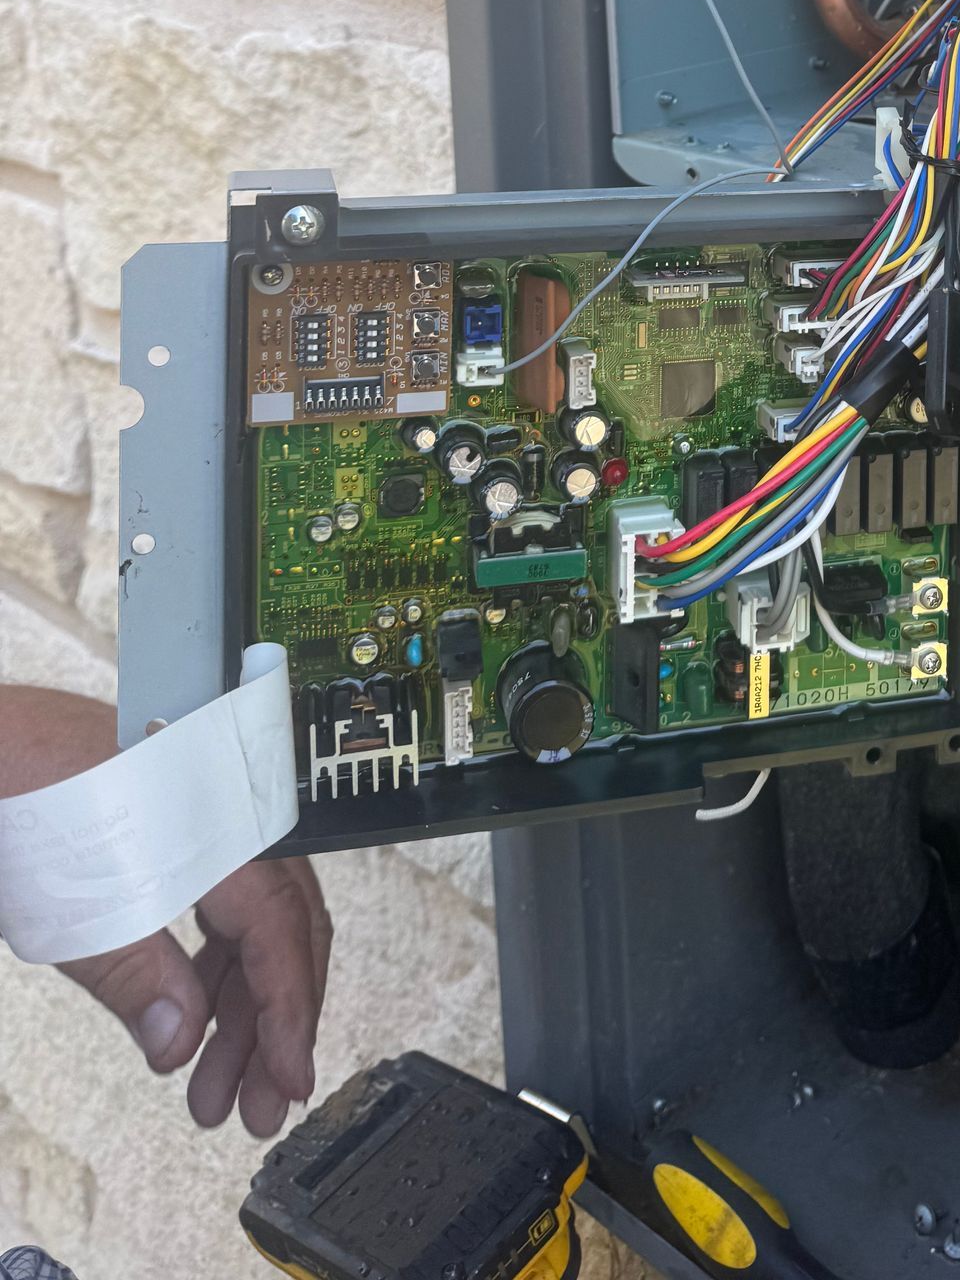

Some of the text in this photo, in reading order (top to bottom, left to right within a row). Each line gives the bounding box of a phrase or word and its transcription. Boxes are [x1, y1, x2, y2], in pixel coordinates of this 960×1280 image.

[347, 303, 364, 312] ON
[440, 310, 449, 331] MAX
[440, 352, 448, 373] MIN
